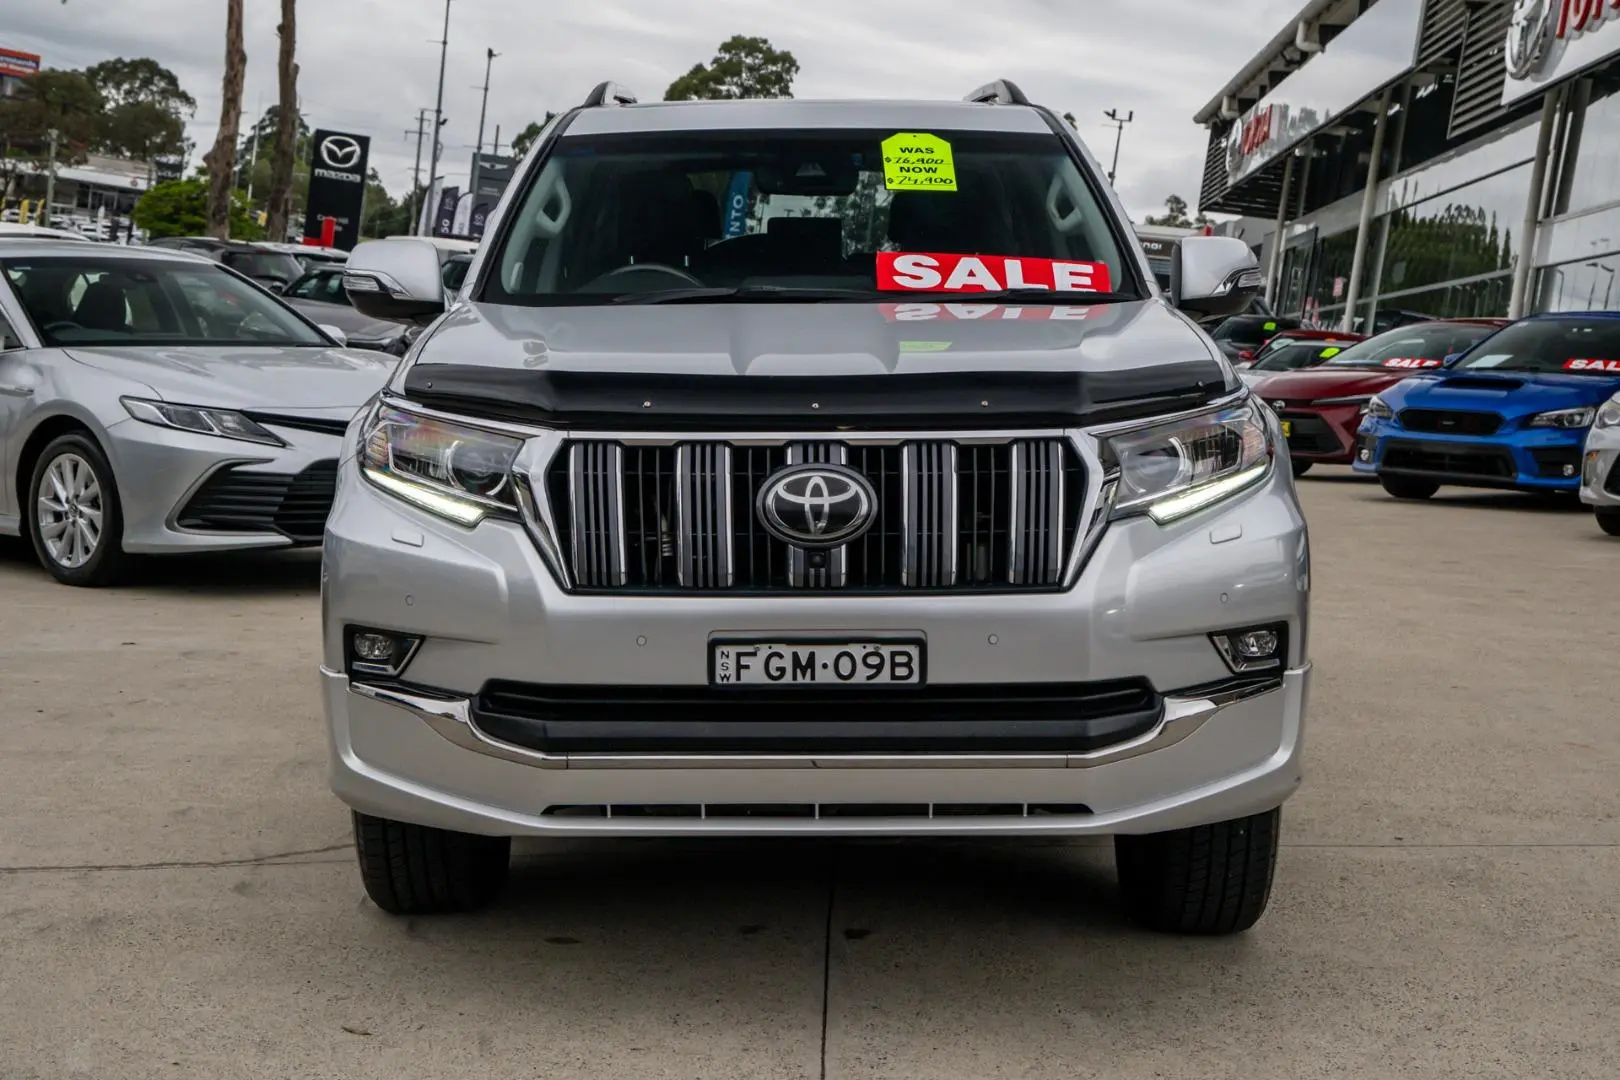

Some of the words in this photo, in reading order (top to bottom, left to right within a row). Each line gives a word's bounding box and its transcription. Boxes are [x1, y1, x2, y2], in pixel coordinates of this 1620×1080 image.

[727, 194, 744, 237] NTO
[892, 254, 1097, 292] SALE
[1384, 358, 1438, 368] SALE
[719, 651, 731, 682] NSW
